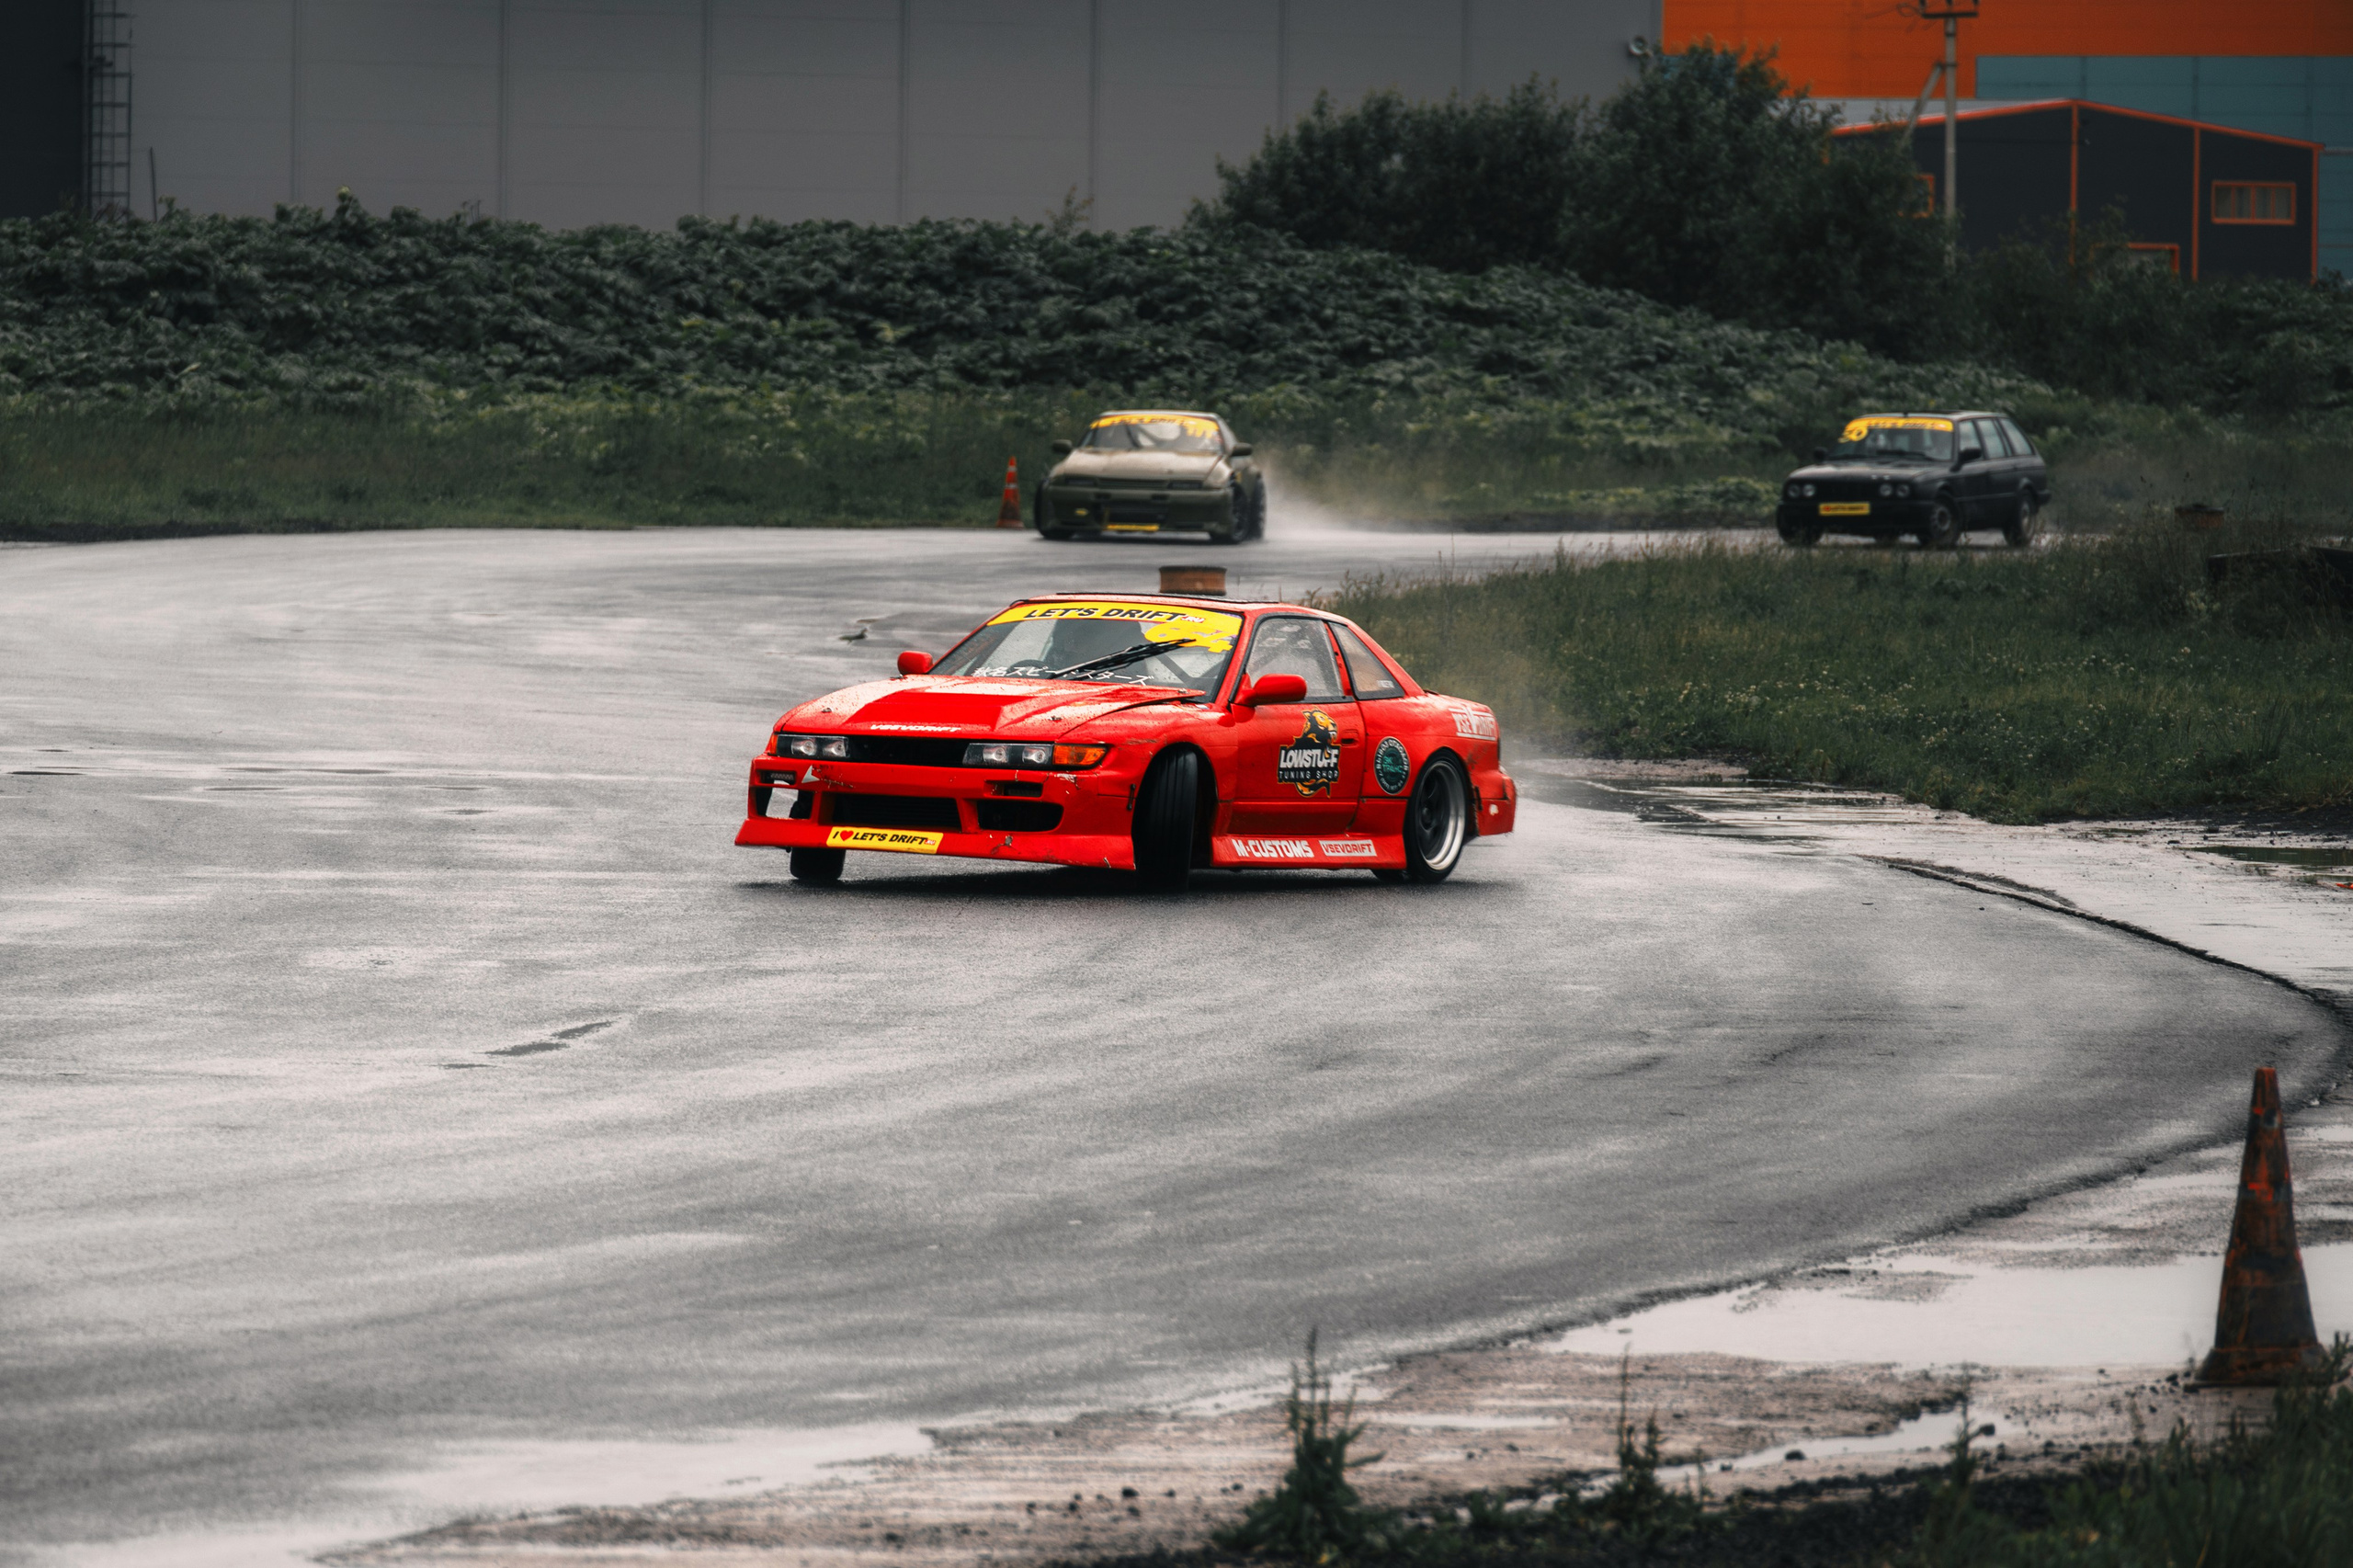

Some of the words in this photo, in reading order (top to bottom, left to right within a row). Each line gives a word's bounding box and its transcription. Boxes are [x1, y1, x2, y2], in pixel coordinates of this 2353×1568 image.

[1023, 608, 1099, 619] LET'S
[1279, 749, 1339, 768] LOWSTUFF
[1279, 770, 1311, 779] TUNING
[1316, 770, 1339, 779] SHOP
[852, 832, 888, 841] LET'S
[1323, 843, 1373, 855] VSEVDRIFT
